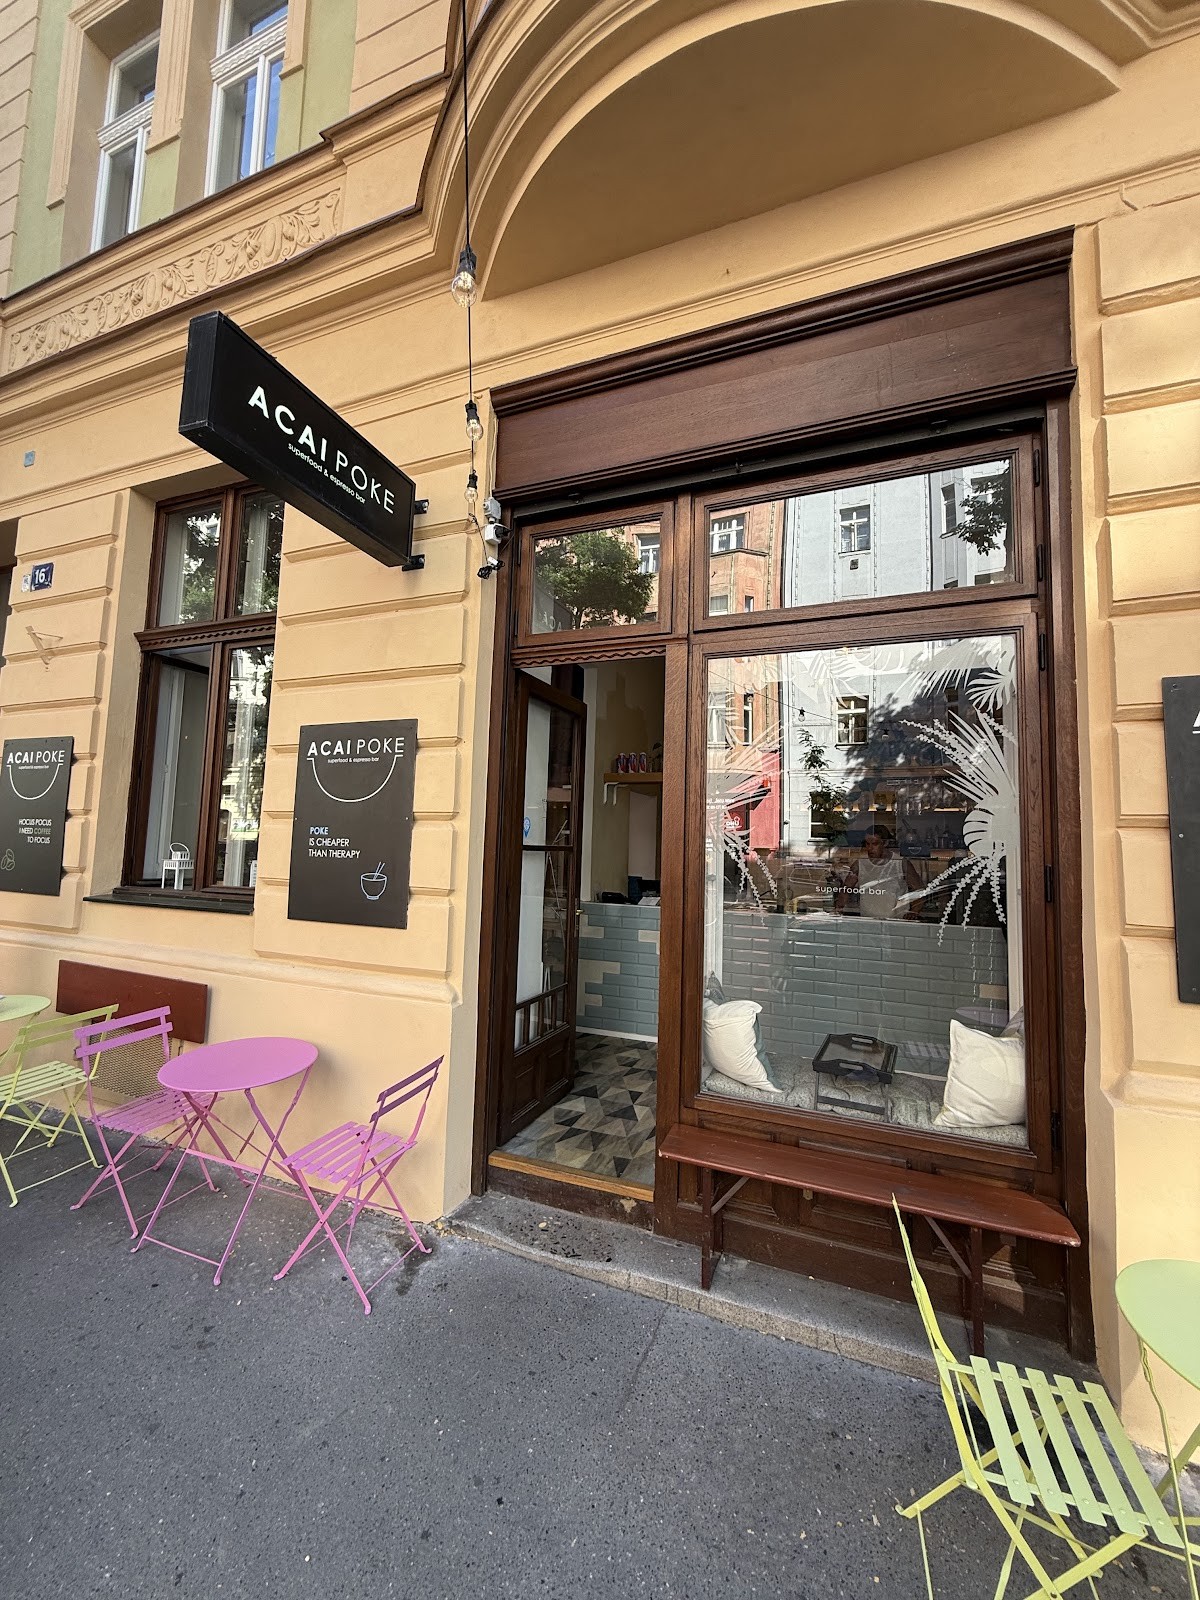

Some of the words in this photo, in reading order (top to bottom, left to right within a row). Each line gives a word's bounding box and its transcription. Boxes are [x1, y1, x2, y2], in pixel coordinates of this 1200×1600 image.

[248, 385, 327, 462] ACAI
[335, 450, 395, 514] POKE
[288, 443, 323, 472] superfood
[324, 469, 329, 477] &
[330, 474, 355, 496] espresso
[355, 492, 366, 504] bar
[35, 568, 46, 584] 16
[307, 740, 351, 756] ACAI
[356, 737, 405, 755] POKE
[6, 751, 34, 764] ACAI
[35, 750, 65, 763] POKE
[309, 826, 329, 836] POKE
[34, 836, 50, 844] FOCUS
[308, 837, 315, 846] IS
[316, 838, 350, 847] CHEAPER
[308, 848, 328, 858] THAN
[329, 849, 361, 859] THERAPY
[815, 885, 865, 895] superfood
[868, 887, 886, 895] bar
